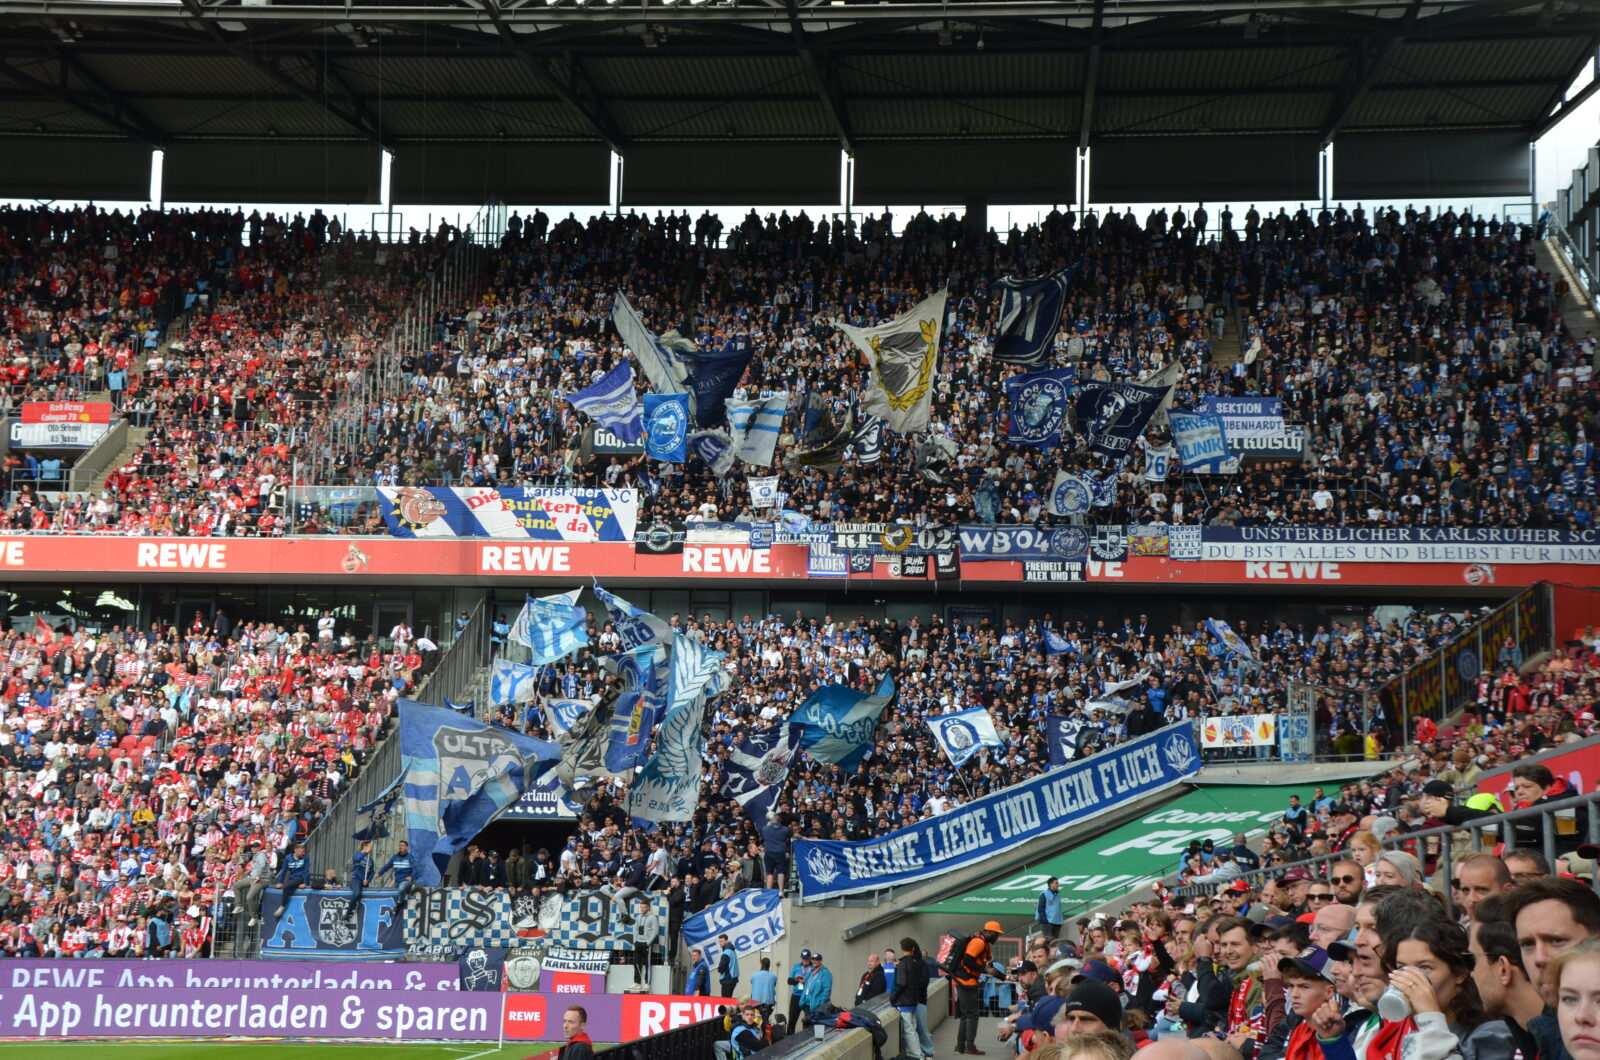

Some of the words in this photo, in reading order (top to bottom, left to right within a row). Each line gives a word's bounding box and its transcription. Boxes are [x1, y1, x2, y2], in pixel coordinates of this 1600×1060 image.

[1216, 402, 1262, 413] SEKTION
[60, 424, 82, 432] School
[466, 490, 500, 510] Die
[523, 487, 602, 498] Karlsruher
[610, 490, 632, 503] SC
[500, 498, 613, 519] Bullterrier
[516, 514, 557, 531] sind
[775, 533, 830, 543] KOLLEKTIV
[1242, 527, 1412, 542] UNSTERBLICHER
[1419, 528, 1562, 543] KARLSRUHER
[1569, 529, 1596, 543] SC
[138, 543, 226, 568] REWE
[482, 546, 570, 571] REWE
[1209, 546, 1239, 559] DU
[1243, 546, 1287, 559] BIST
[1295, 546, 1356, 559] ALLES
[1364, 546, 1410, 559] UND
[1416, 547, 1502, 560] BLEIBST
[1510, 544, 1553, 560] FÜR
[683, 548, 771, 573] REWE
[810, 558, 846, 570] BADEN
[1025, 561, 1062, 571] FREIHEIT
[1026, 571, 1048, 581] ALEX
[1050, 571, 1068, 581] UND
[1245, 561, 1341, 579] REWE
[443, 734, 518, 756] ULTRA
[842, 832, 925, 880] MEINE
[926, 809, 992, 862] LIEBE
[998, 790, 1041, 839] UND
[1041, 767, 1100, 821] MEIN
[1099, 743, 1164, 800] FLUCH
[704, 890, 769, 933] KSC
[704, 915, 786, 966] Feak
[548, 948, 611, 959] WESTSIDE
[545, 961, 607, 971] KARLSRUHE
[556, 984, 586, 994] REWE
[13, 994, 82, 1035] App
[93, 994, 327, 1029] herunterladen
[340, 995, 365, 1030] &
[377, 1003, 487, 1038] sparen
[509, 1011, 541, 1022] REWE
